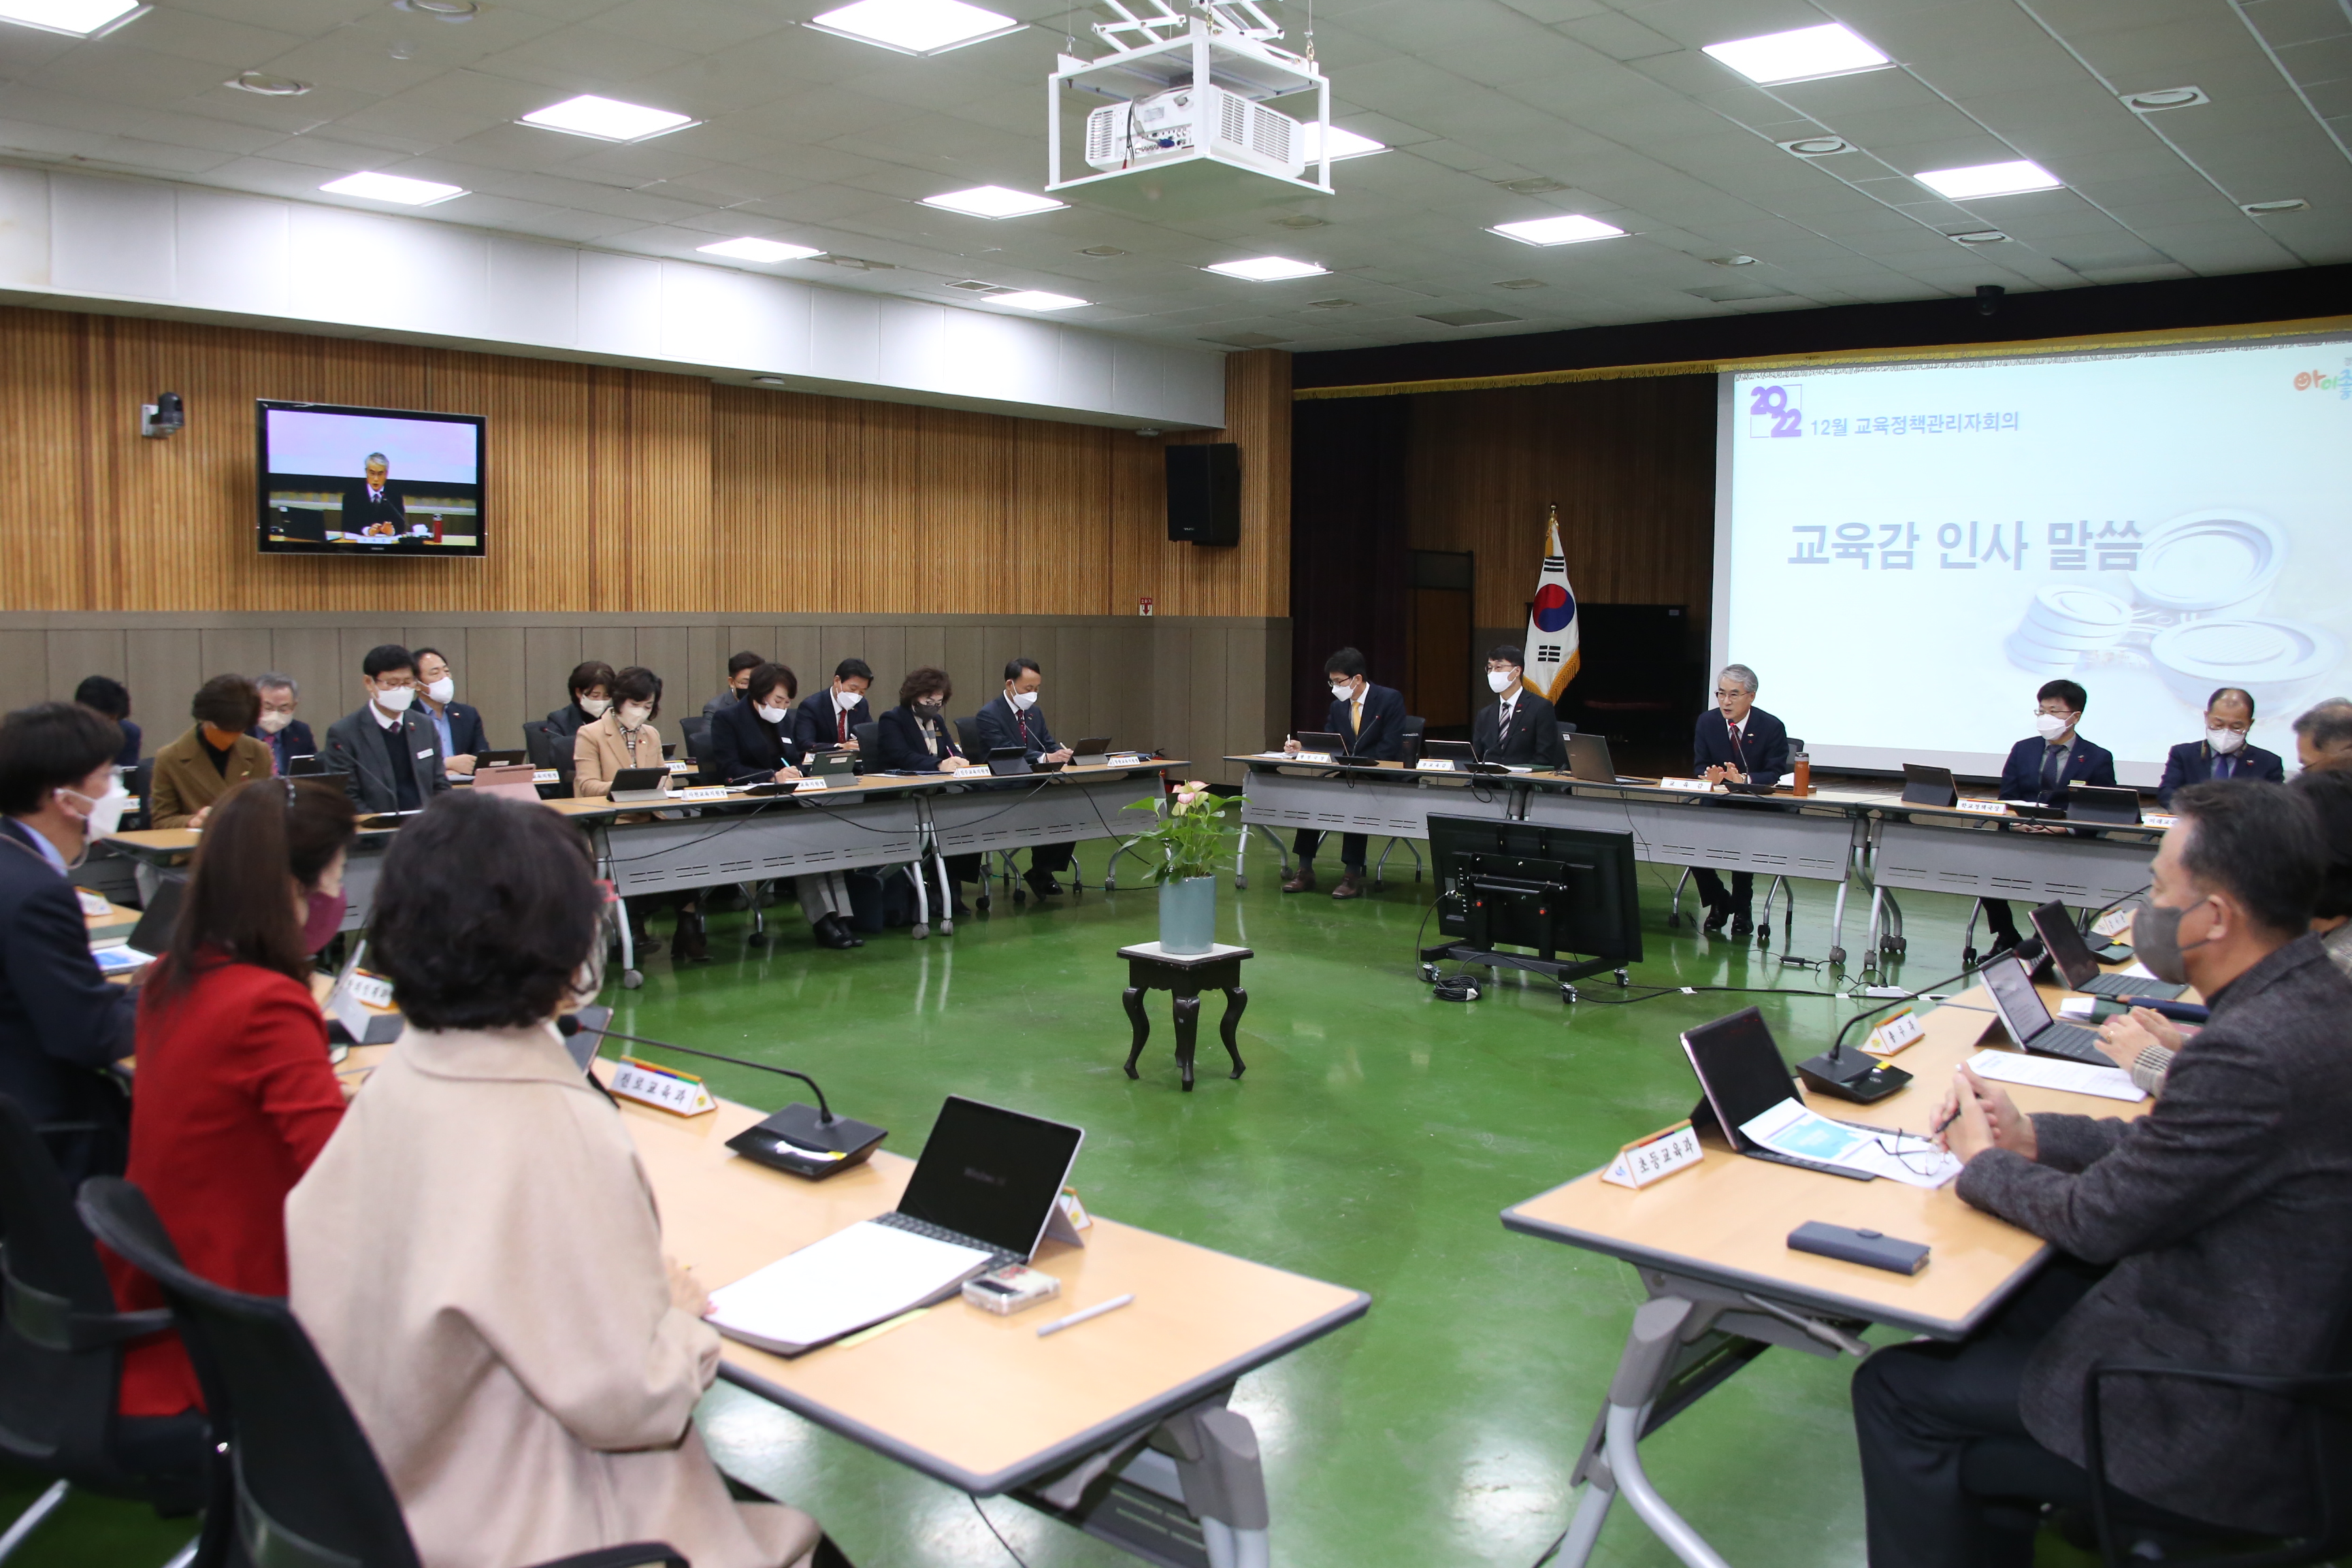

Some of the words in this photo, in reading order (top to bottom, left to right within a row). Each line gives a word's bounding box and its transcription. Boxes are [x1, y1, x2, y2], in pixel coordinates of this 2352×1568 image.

[1811, 418, 1848, 436] 12월
[1855, 412, 2019, 435] 교육정책관리자회의
[1787, 521, 1919, 570] 교육감
[1937, 521, 2028, 570] 인사
[2048, 520, 2143, 571] 말씀
[1961, 803, 2000, 811] 학교정책국장
[1639, 1137, 1694, 1173] 초등교육과
